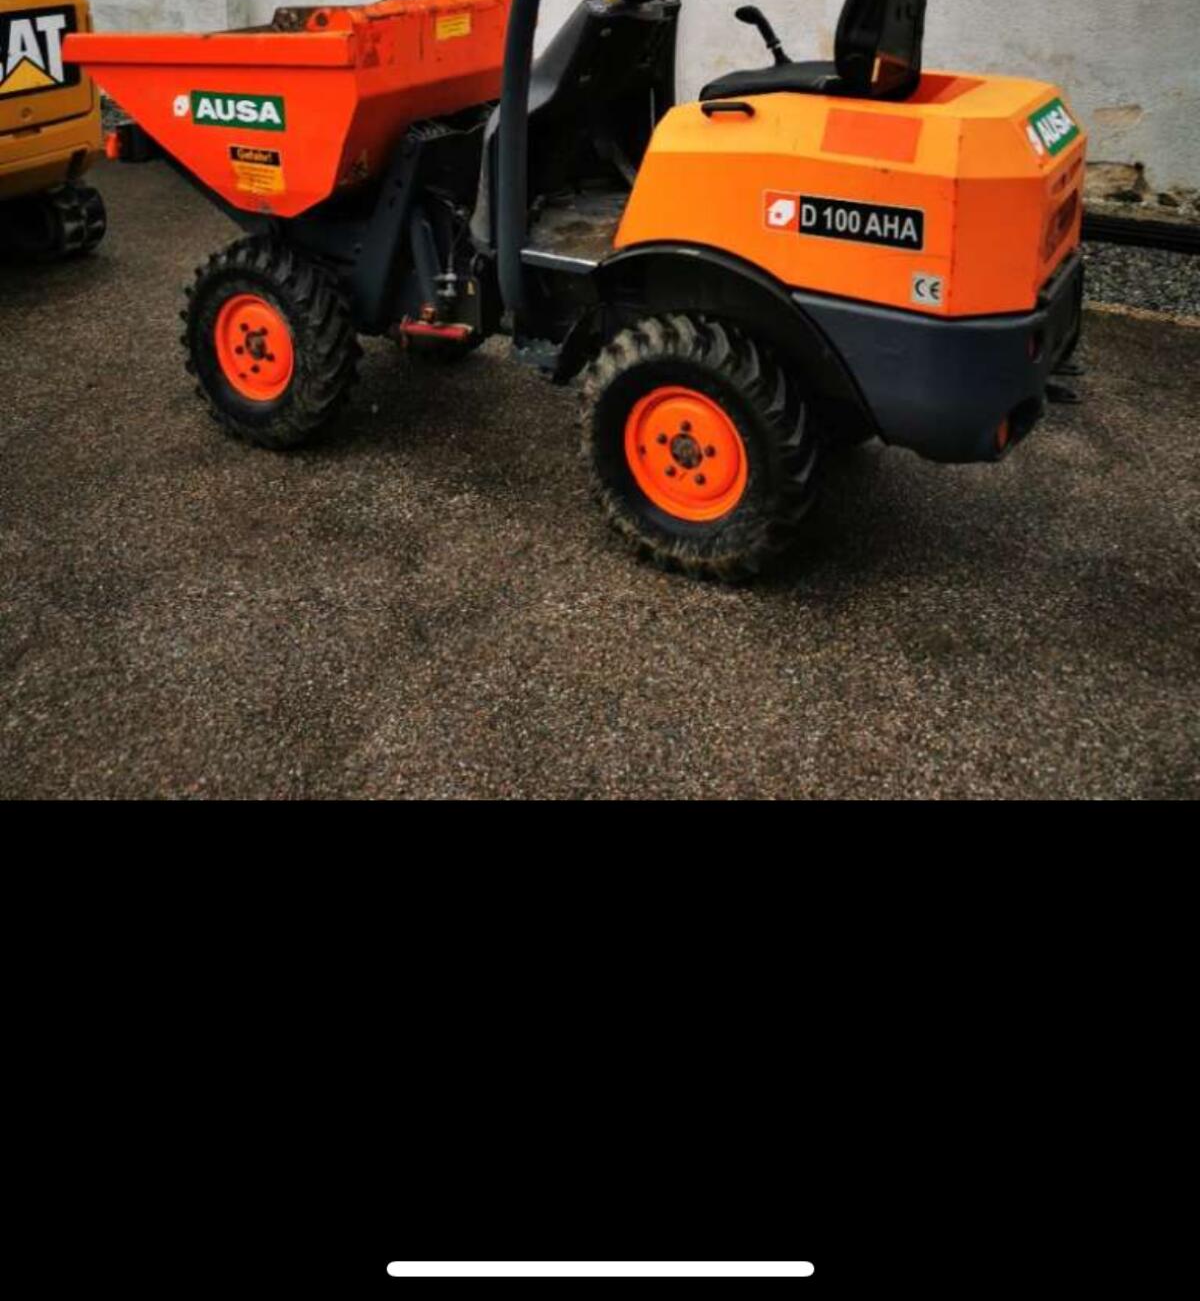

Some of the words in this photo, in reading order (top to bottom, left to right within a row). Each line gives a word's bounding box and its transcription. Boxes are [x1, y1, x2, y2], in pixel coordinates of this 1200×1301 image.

[0, 13, 66, 83] AT
[196, 97, 281, 124] AUSA
[1036, 105, 1075, 148] AUSA
[801, 204, 817, 227] D
[823, 207, 860, 233] 100
[864, 212, 918, 242] AHA
